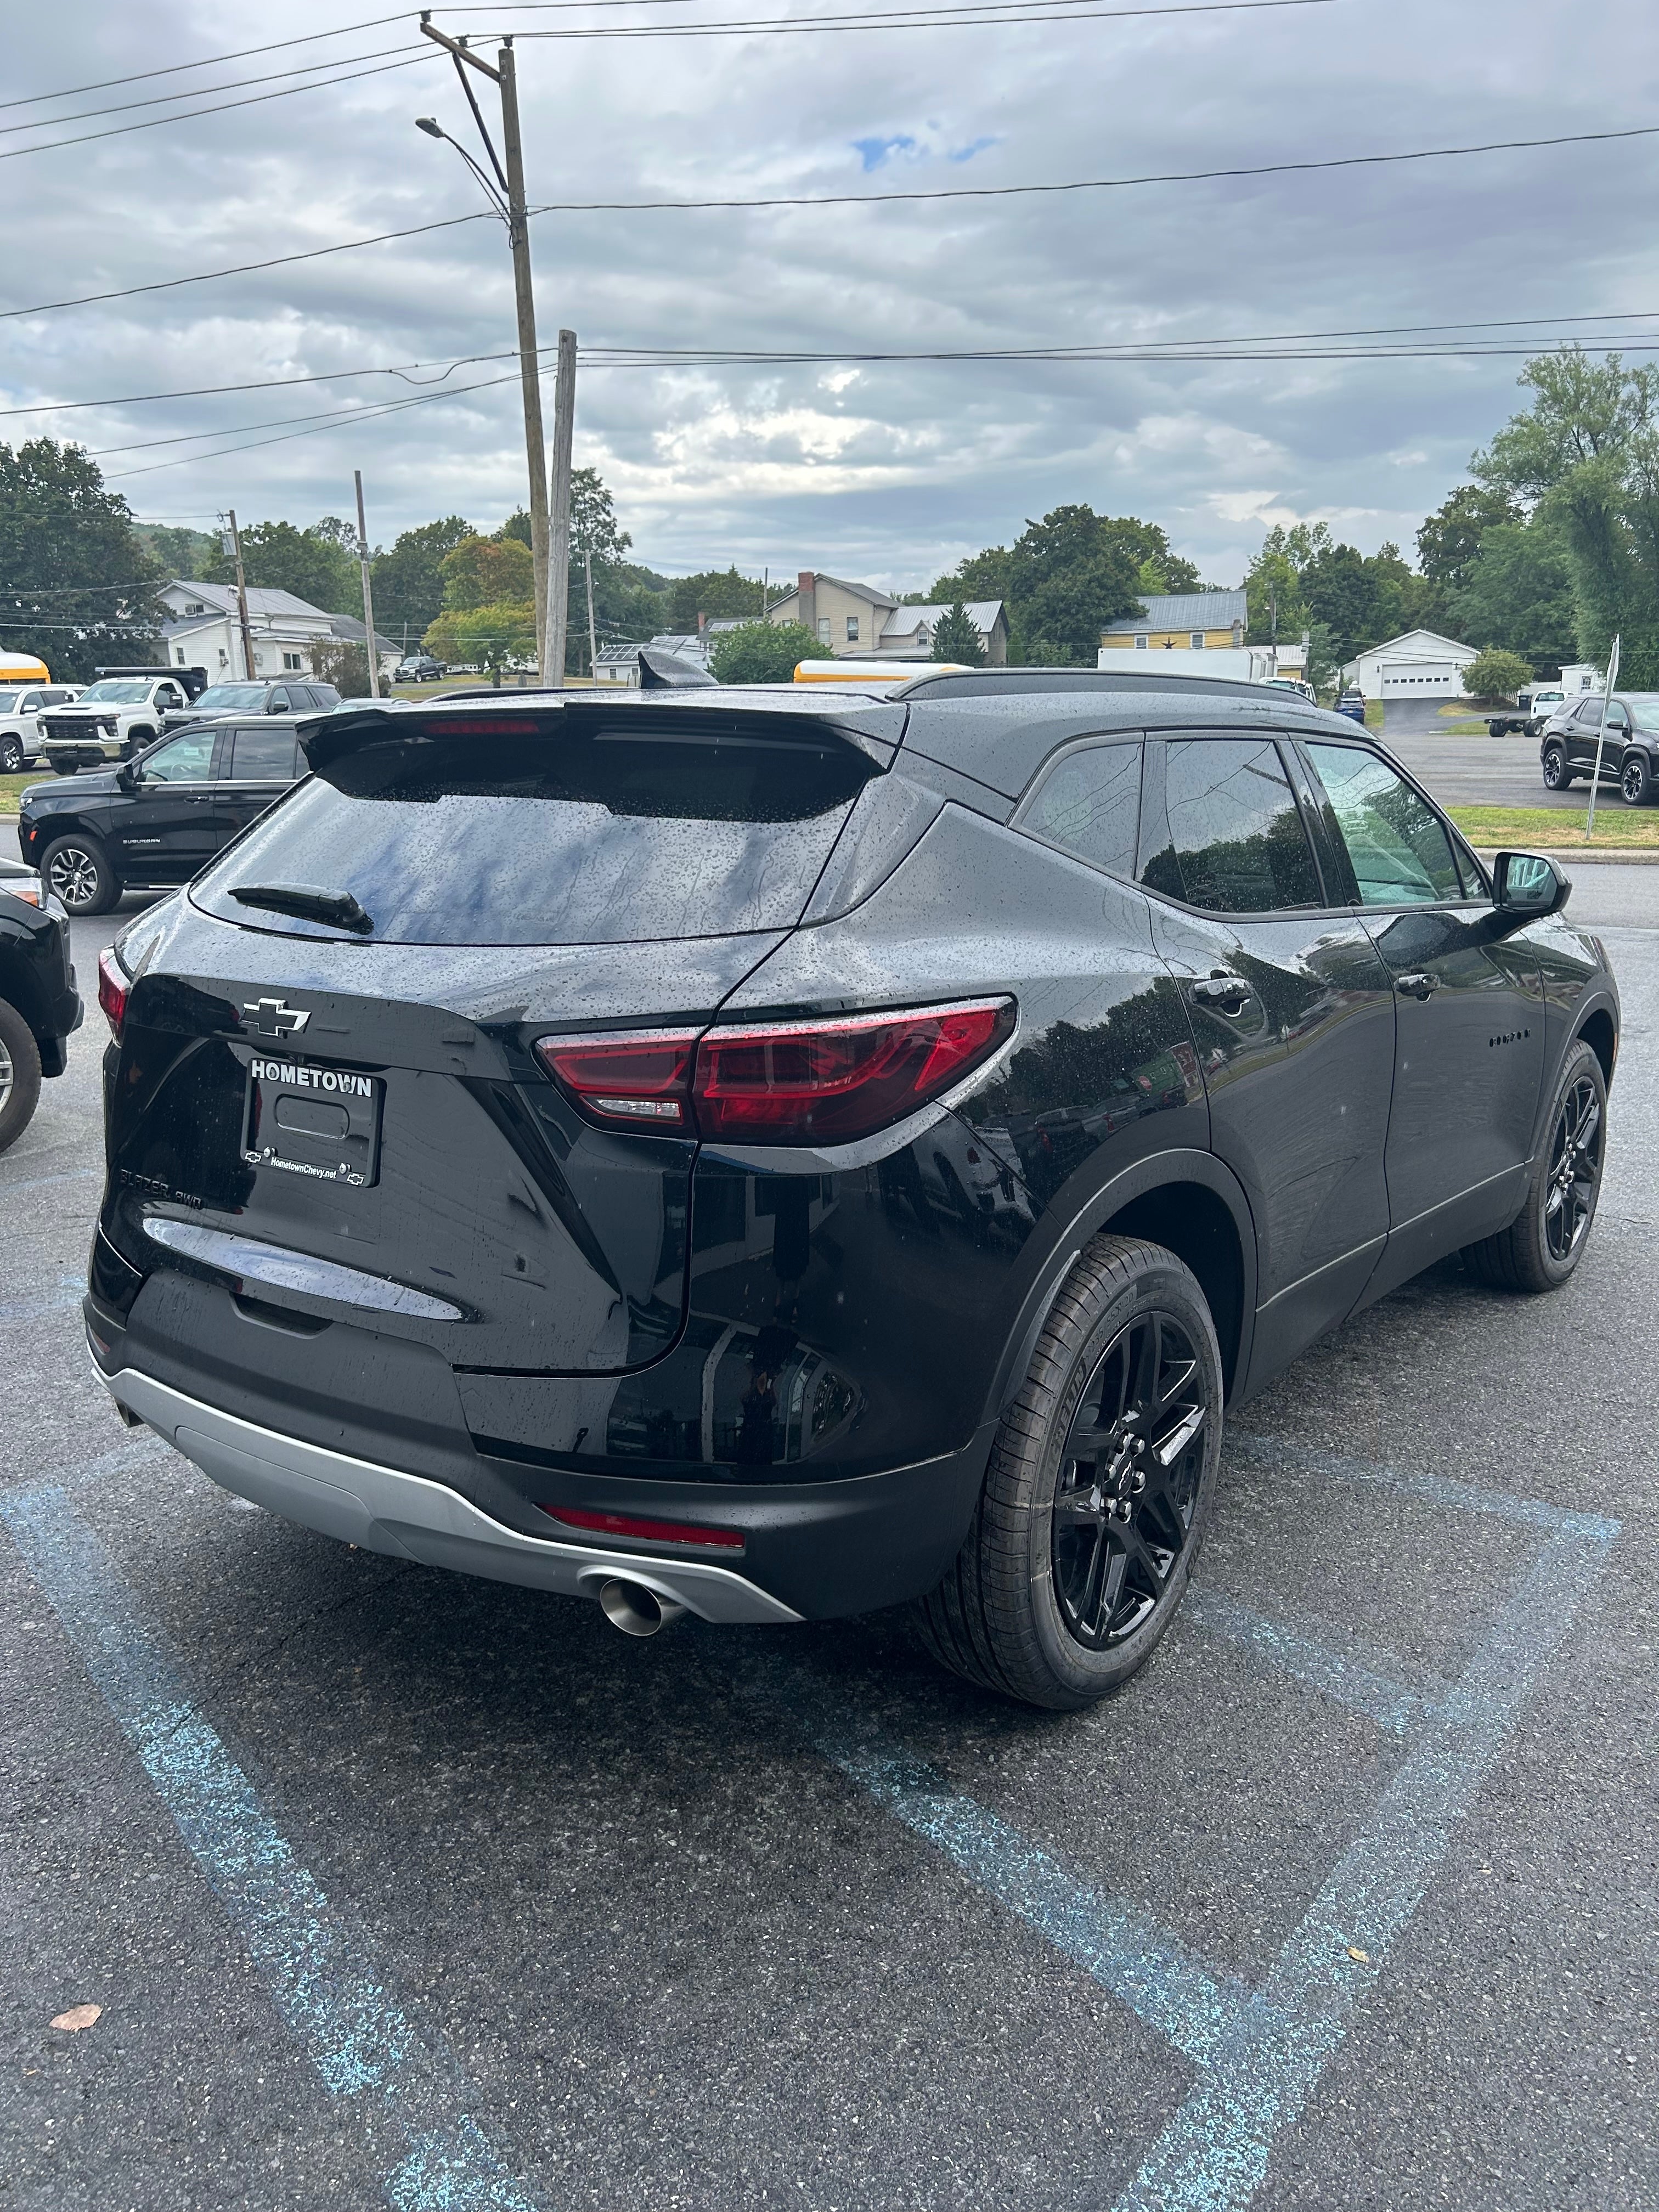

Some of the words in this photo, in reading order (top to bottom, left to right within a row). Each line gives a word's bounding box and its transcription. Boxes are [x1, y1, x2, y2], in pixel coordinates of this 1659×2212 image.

[251, 1059, 372, 1097] HOMETOWN
[270, 1157, 337, 1180] HometownChevy.net
[121, 1169, 171, 1199] BLAZER
[175, 1190, 203, 1210] AWD
